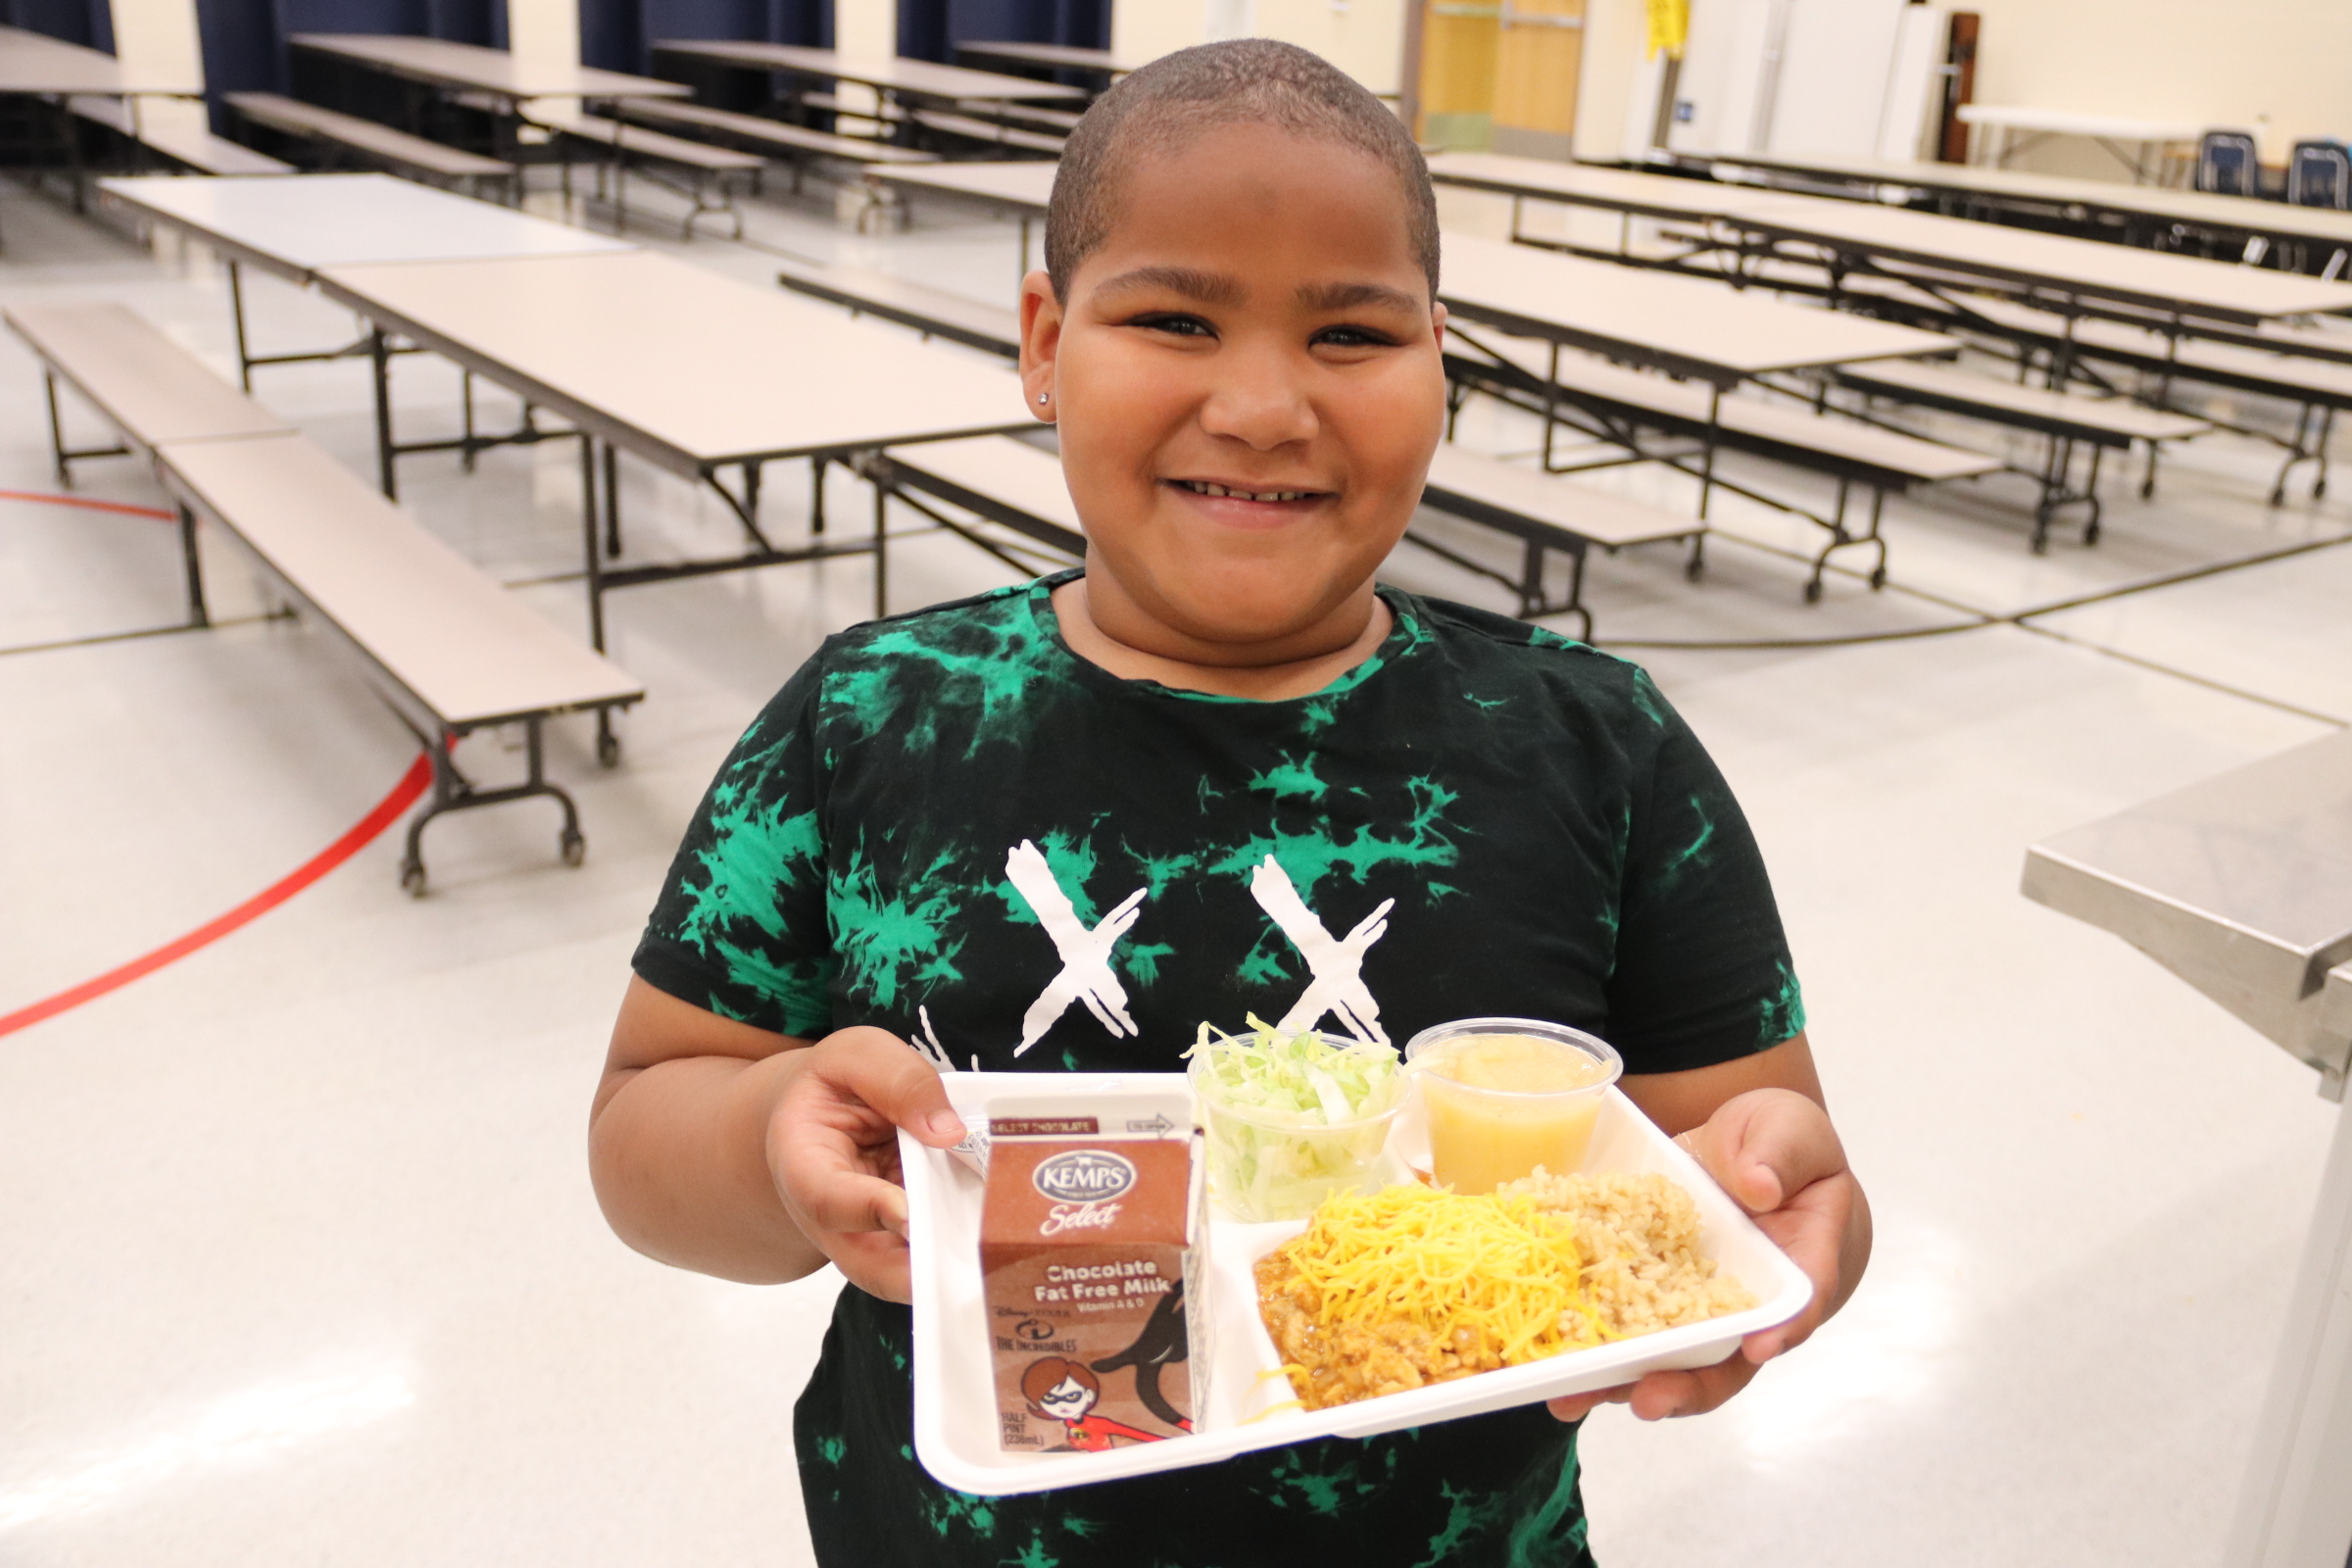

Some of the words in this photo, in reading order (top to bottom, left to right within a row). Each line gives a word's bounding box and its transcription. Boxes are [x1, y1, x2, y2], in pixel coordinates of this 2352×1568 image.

[1031, 1121, 1091, 1133] CHOCOLATE
[1043, 1166, 1126, 1190] KEMPS
[1039, 1201, 1123, 1237] Select
[1046, 1260, 1157, 1283] Chocolate
[1034, 1286, 1070, 1302] Fat
[1072, 1283, 1119, 1299] Free
[1123, 1276, 1172, 1295] Milk
[1076, 1300, 1116, 1312] Vitamin
[1116, 1298, 1126, 1309] A
[1135, 1297, 1146, 1308] D
[996, 1336, 1015, 1351] THE
[1002, 1412, 1028, 1423] HALF
[1003, 1423, 1026, 1434] PINT
[1004, 1433, 1045, 1447] (236mL)
